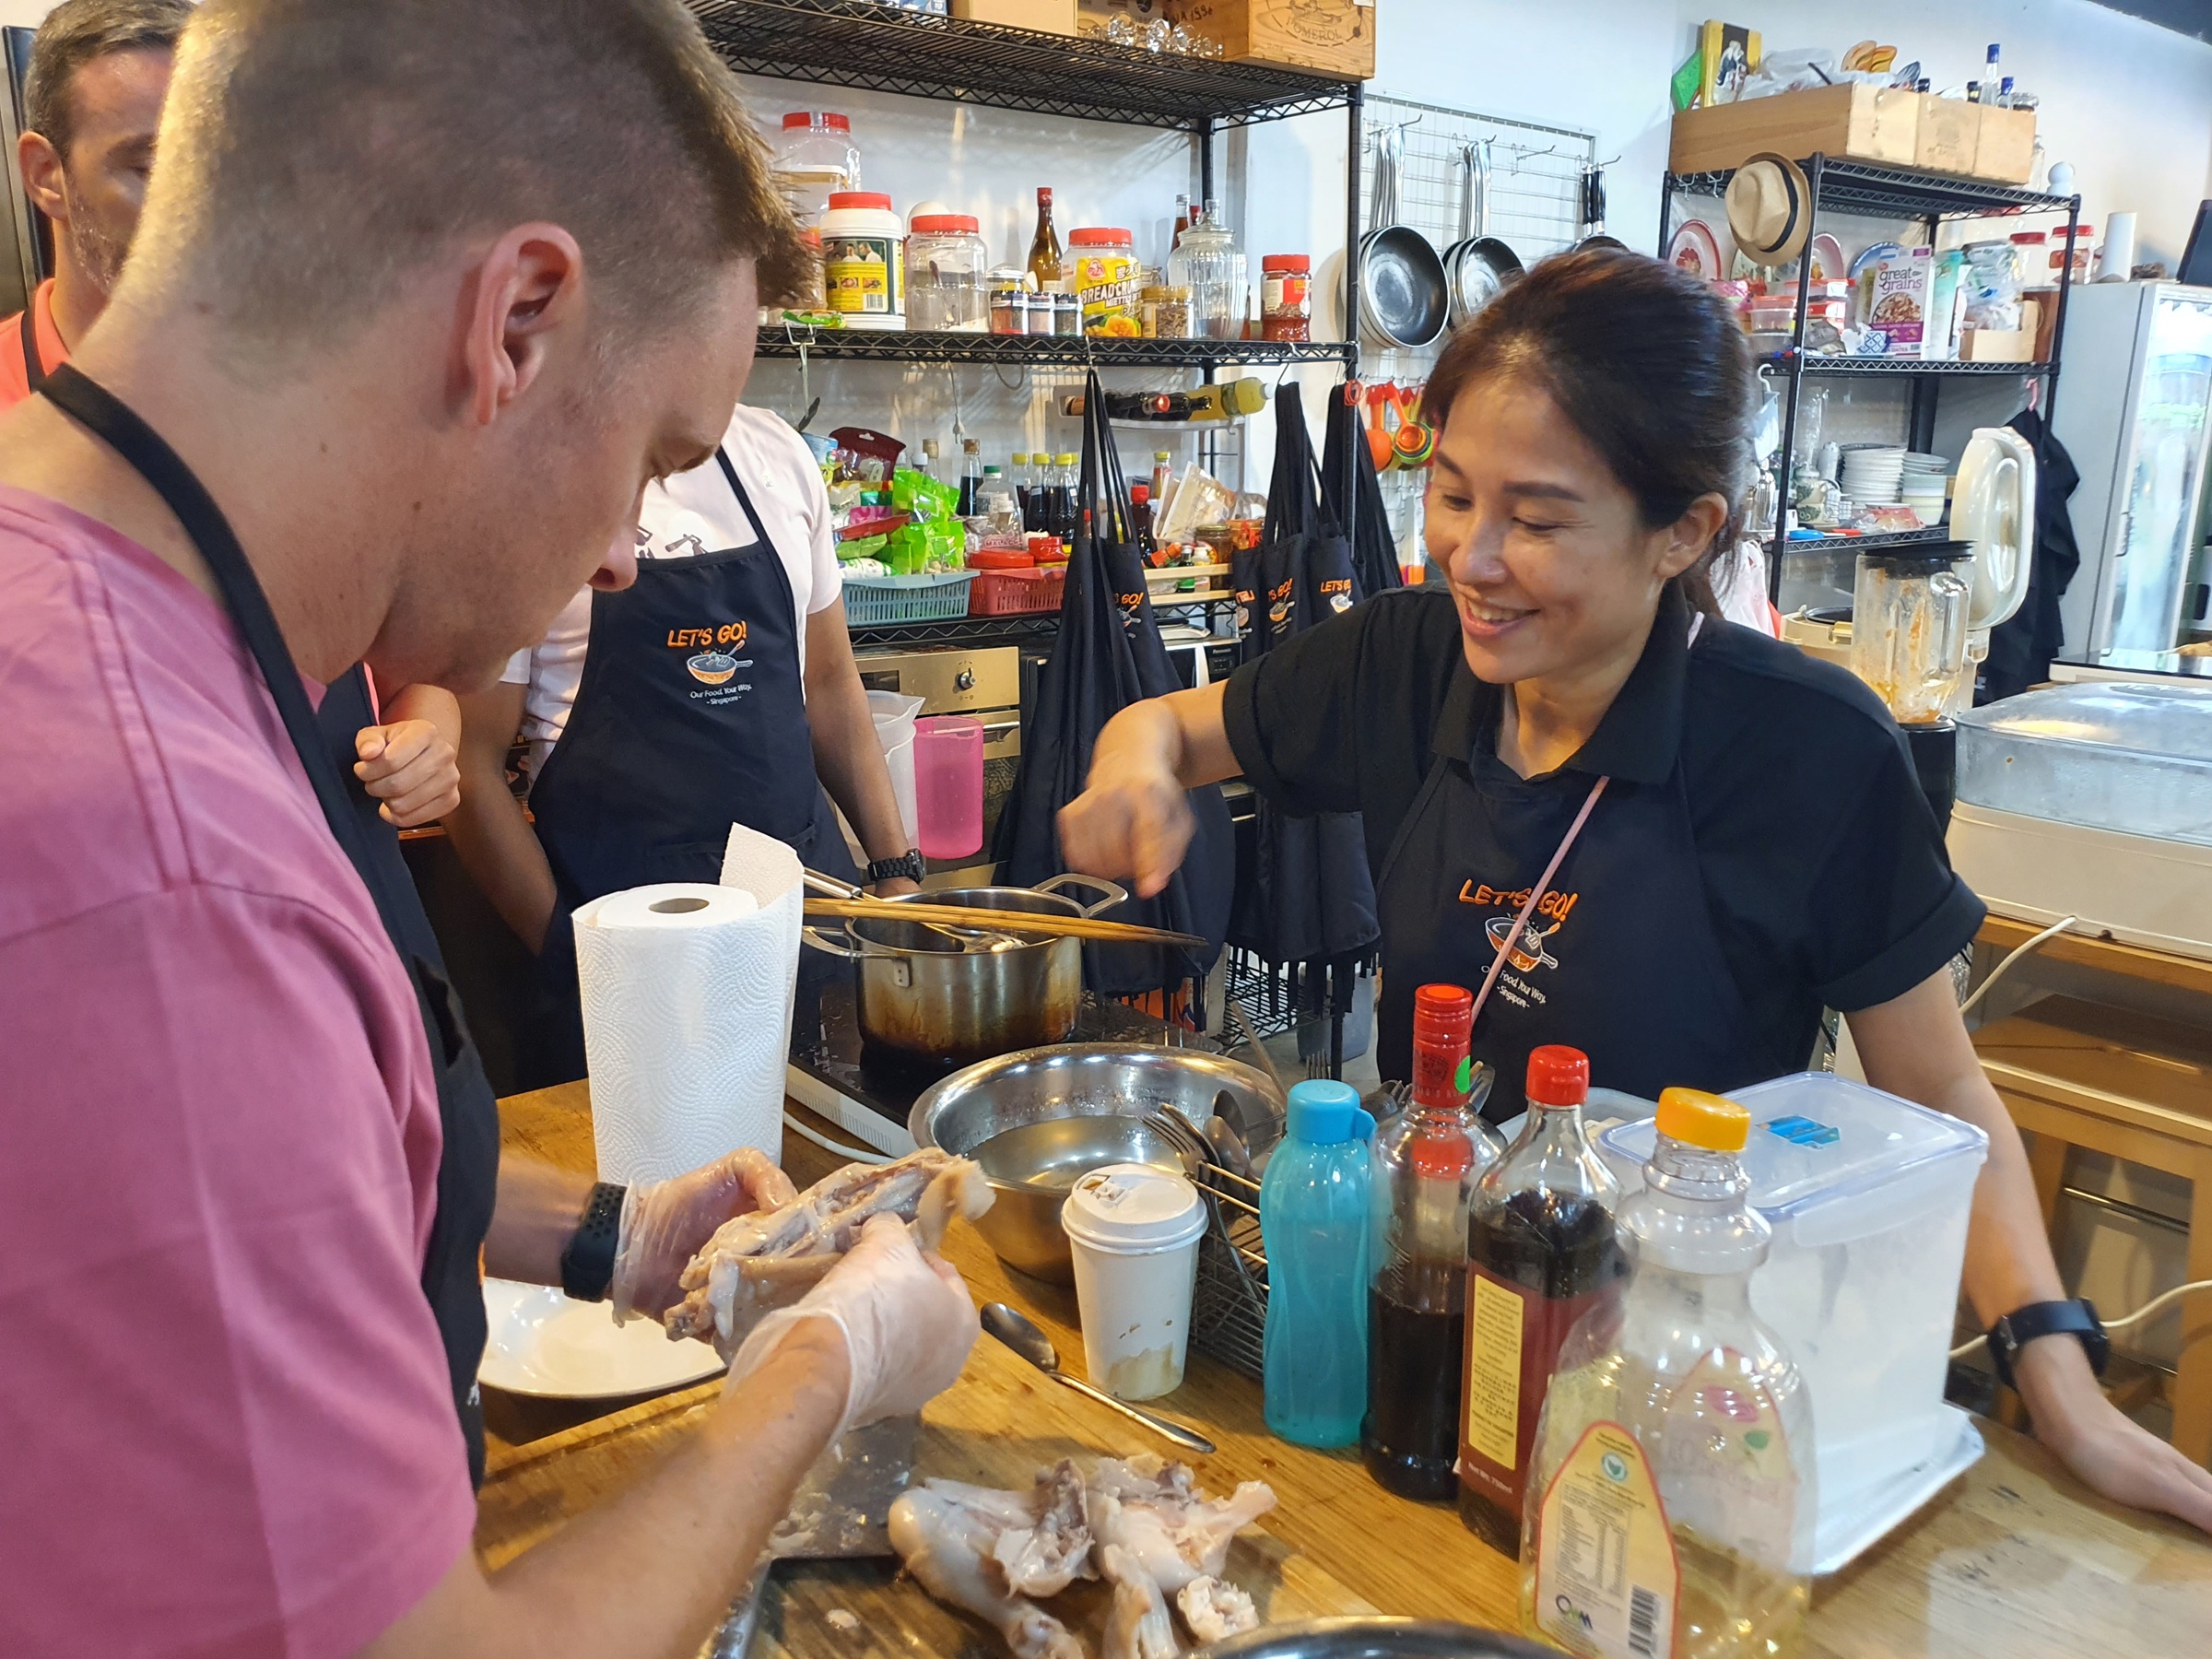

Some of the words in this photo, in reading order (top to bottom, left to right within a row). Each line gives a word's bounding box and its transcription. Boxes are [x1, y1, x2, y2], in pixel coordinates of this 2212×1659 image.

[1879, 266, 1912, 287] great
[1881, 277, 1923, 295] grains
[1082, 283, 1115, 304] BREAD
[1277, 577, 1293, 597] GO!
[1122, 592, 1144, 605] GO!
[667, 628, 712, 647] LET'S
[717, 620, 747, 644] GO!
[690, 690, 704, 699] Our
[724, 686, 737, 694] Your
[1459, 878, 1535, 909] LET'S
[1537, 890, 1579, 922] GO!
[1518, 979, 1531, 995] Your
